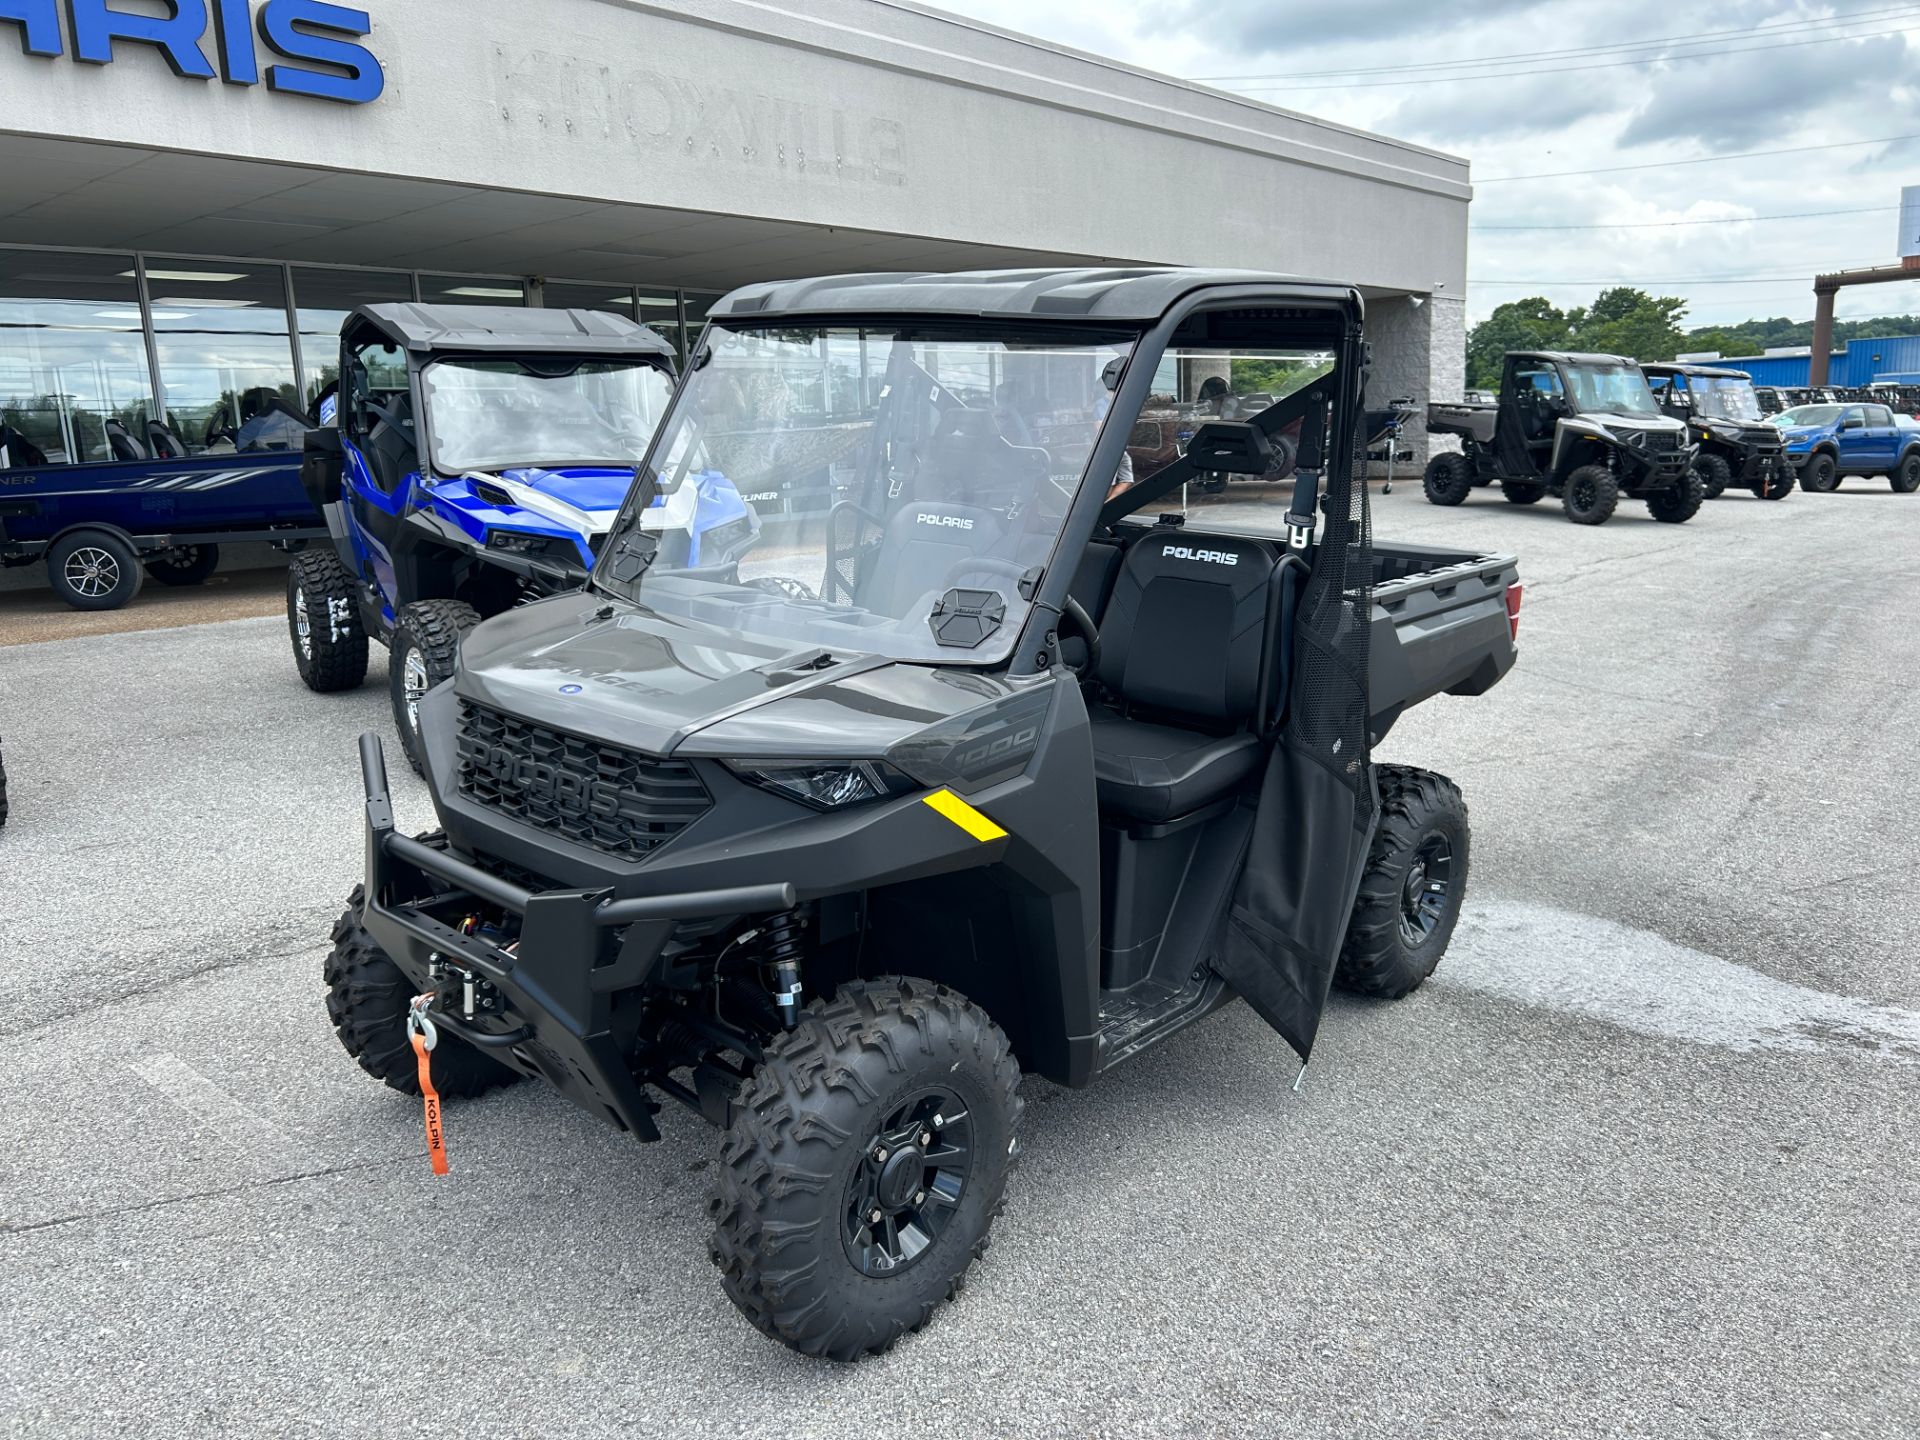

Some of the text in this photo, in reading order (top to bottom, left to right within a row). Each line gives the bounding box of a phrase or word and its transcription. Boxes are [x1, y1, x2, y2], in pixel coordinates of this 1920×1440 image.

[916, 513, 975, 530] POLARIS
[1162, 545, 1239, 566] POLARIS
[511, 655, 675, 698] RANGER
[954, 726, 1037, 770] 1000
[471, 737, 621, 818] POLARIS
[427, 1099, 441, 1150] KOLPIN
